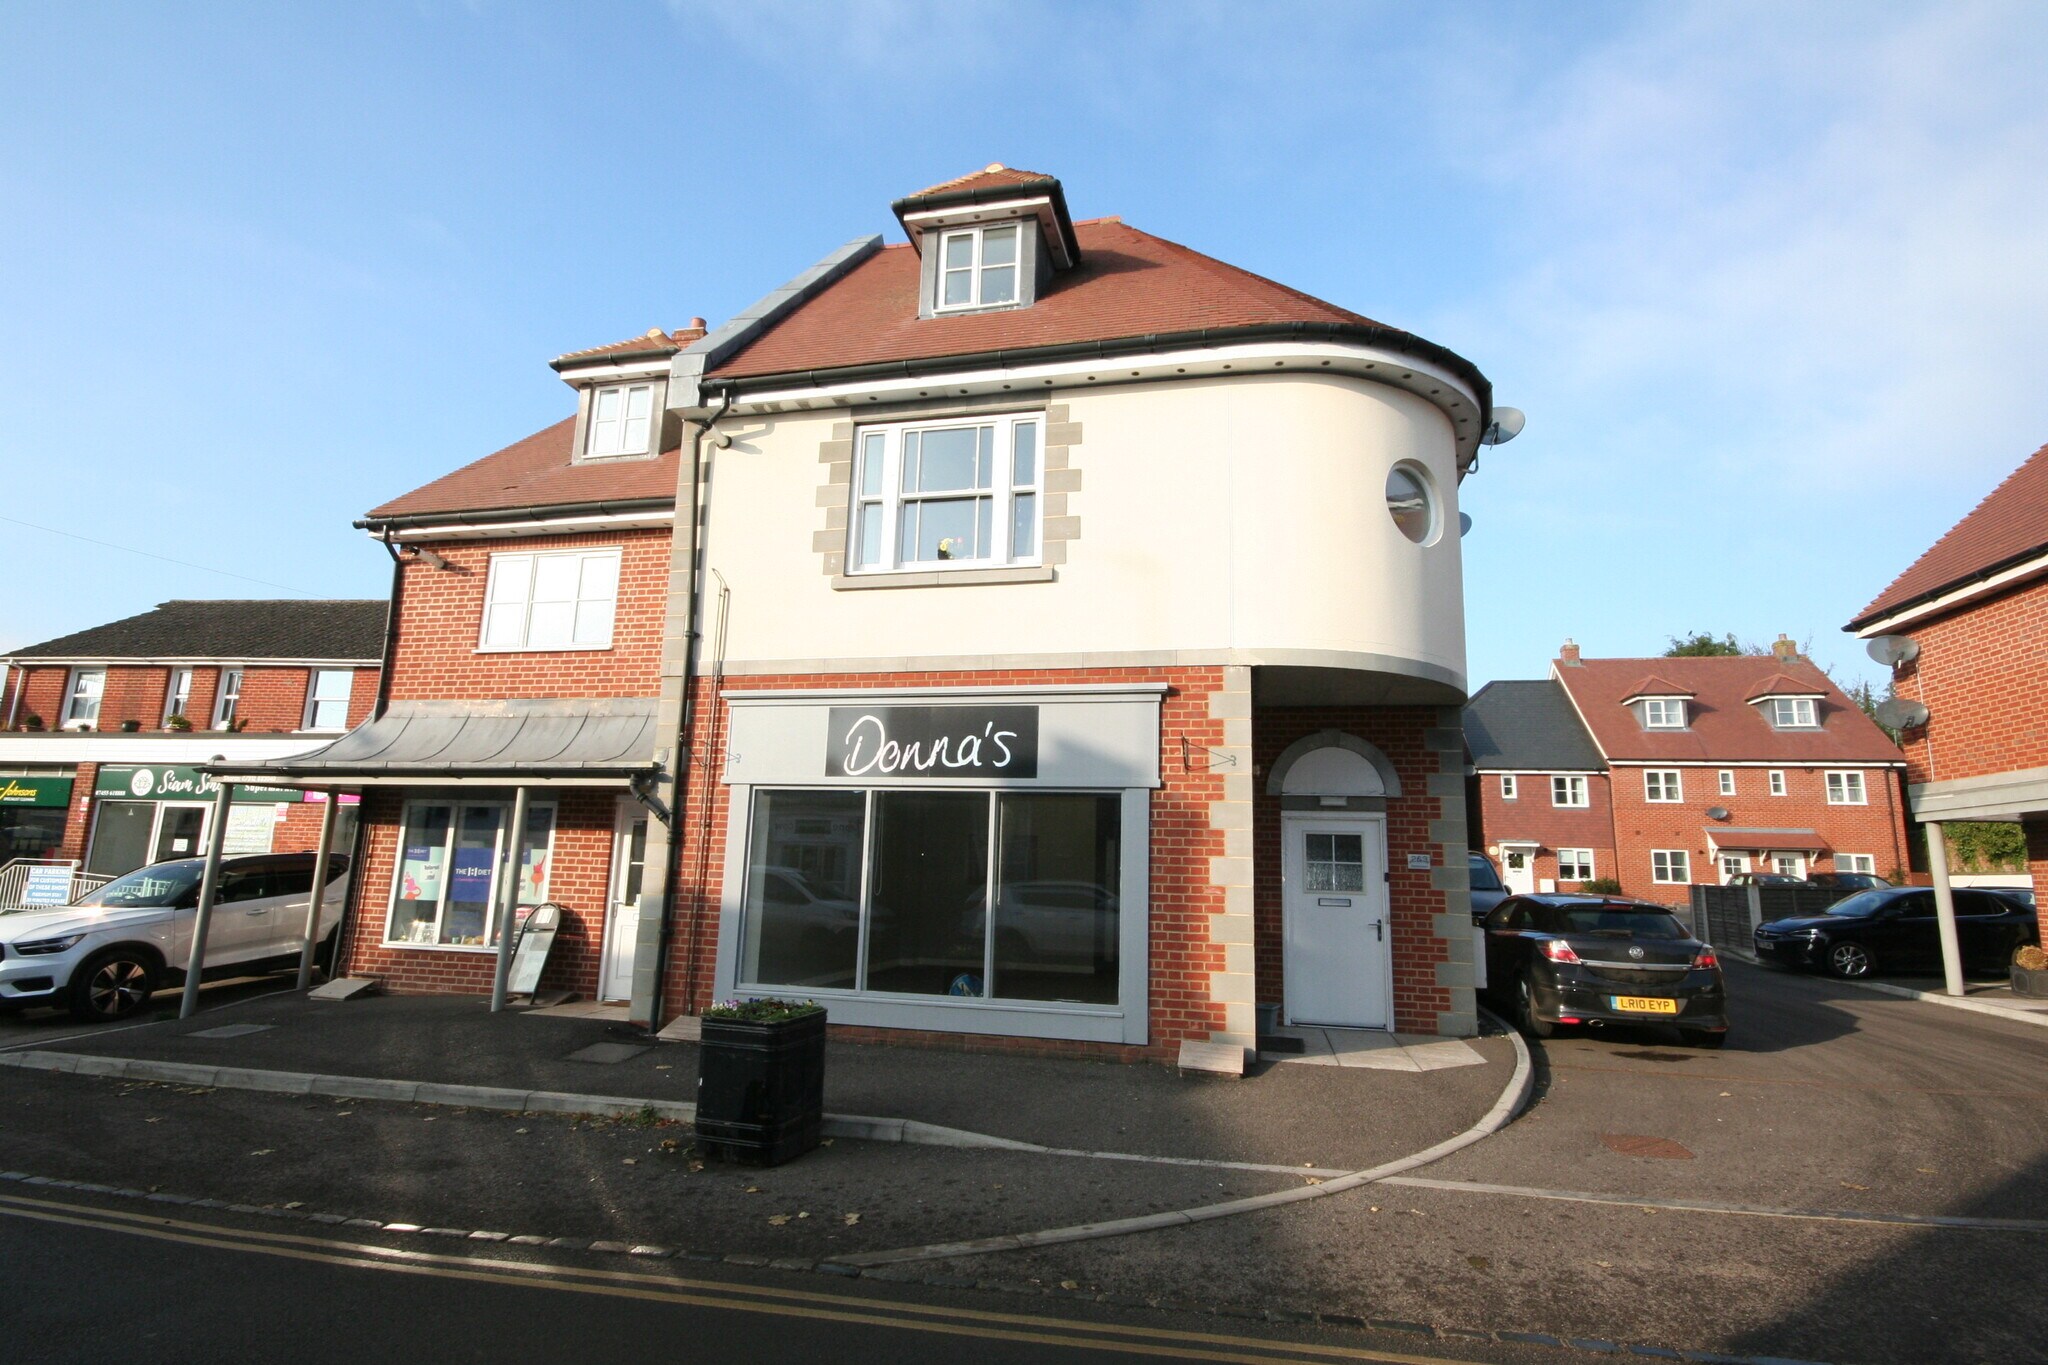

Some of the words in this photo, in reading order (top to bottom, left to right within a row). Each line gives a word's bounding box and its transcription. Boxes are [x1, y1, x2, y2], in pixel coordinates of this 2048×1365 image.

[843, 714, 1018, 776] Donna's
[157, 770, 193, 794] Siam
[244, 784, 298, 793] Superma
[1620, 998, 1646, 1009] LR10
[1648, 999, 1670, 1010] EYP
